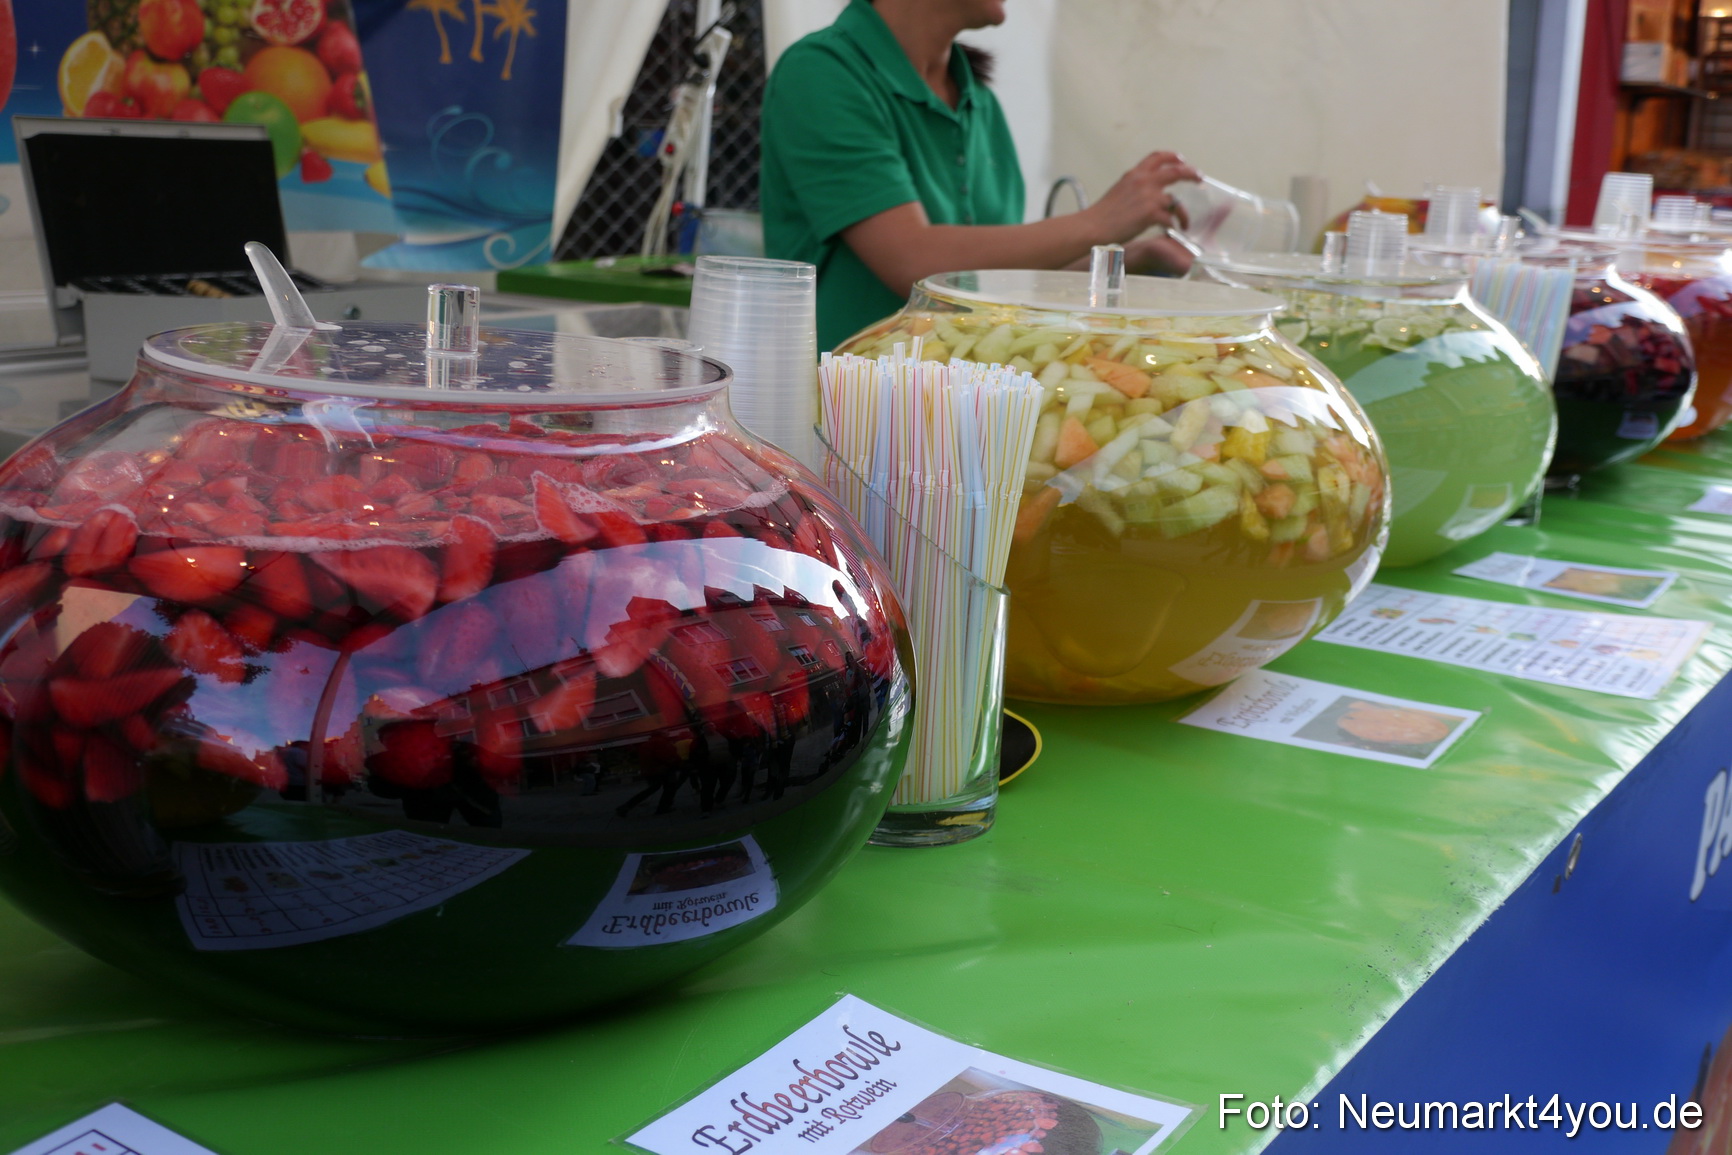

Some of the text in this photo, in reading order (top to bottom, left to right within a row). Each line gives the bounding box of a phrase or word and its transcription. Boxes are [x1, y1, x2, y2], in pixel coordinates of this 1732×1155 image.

[692, 1024, 902, 1155] Erdbeerbowle
[798, 1078, 898, 1144] mit Rotwein
